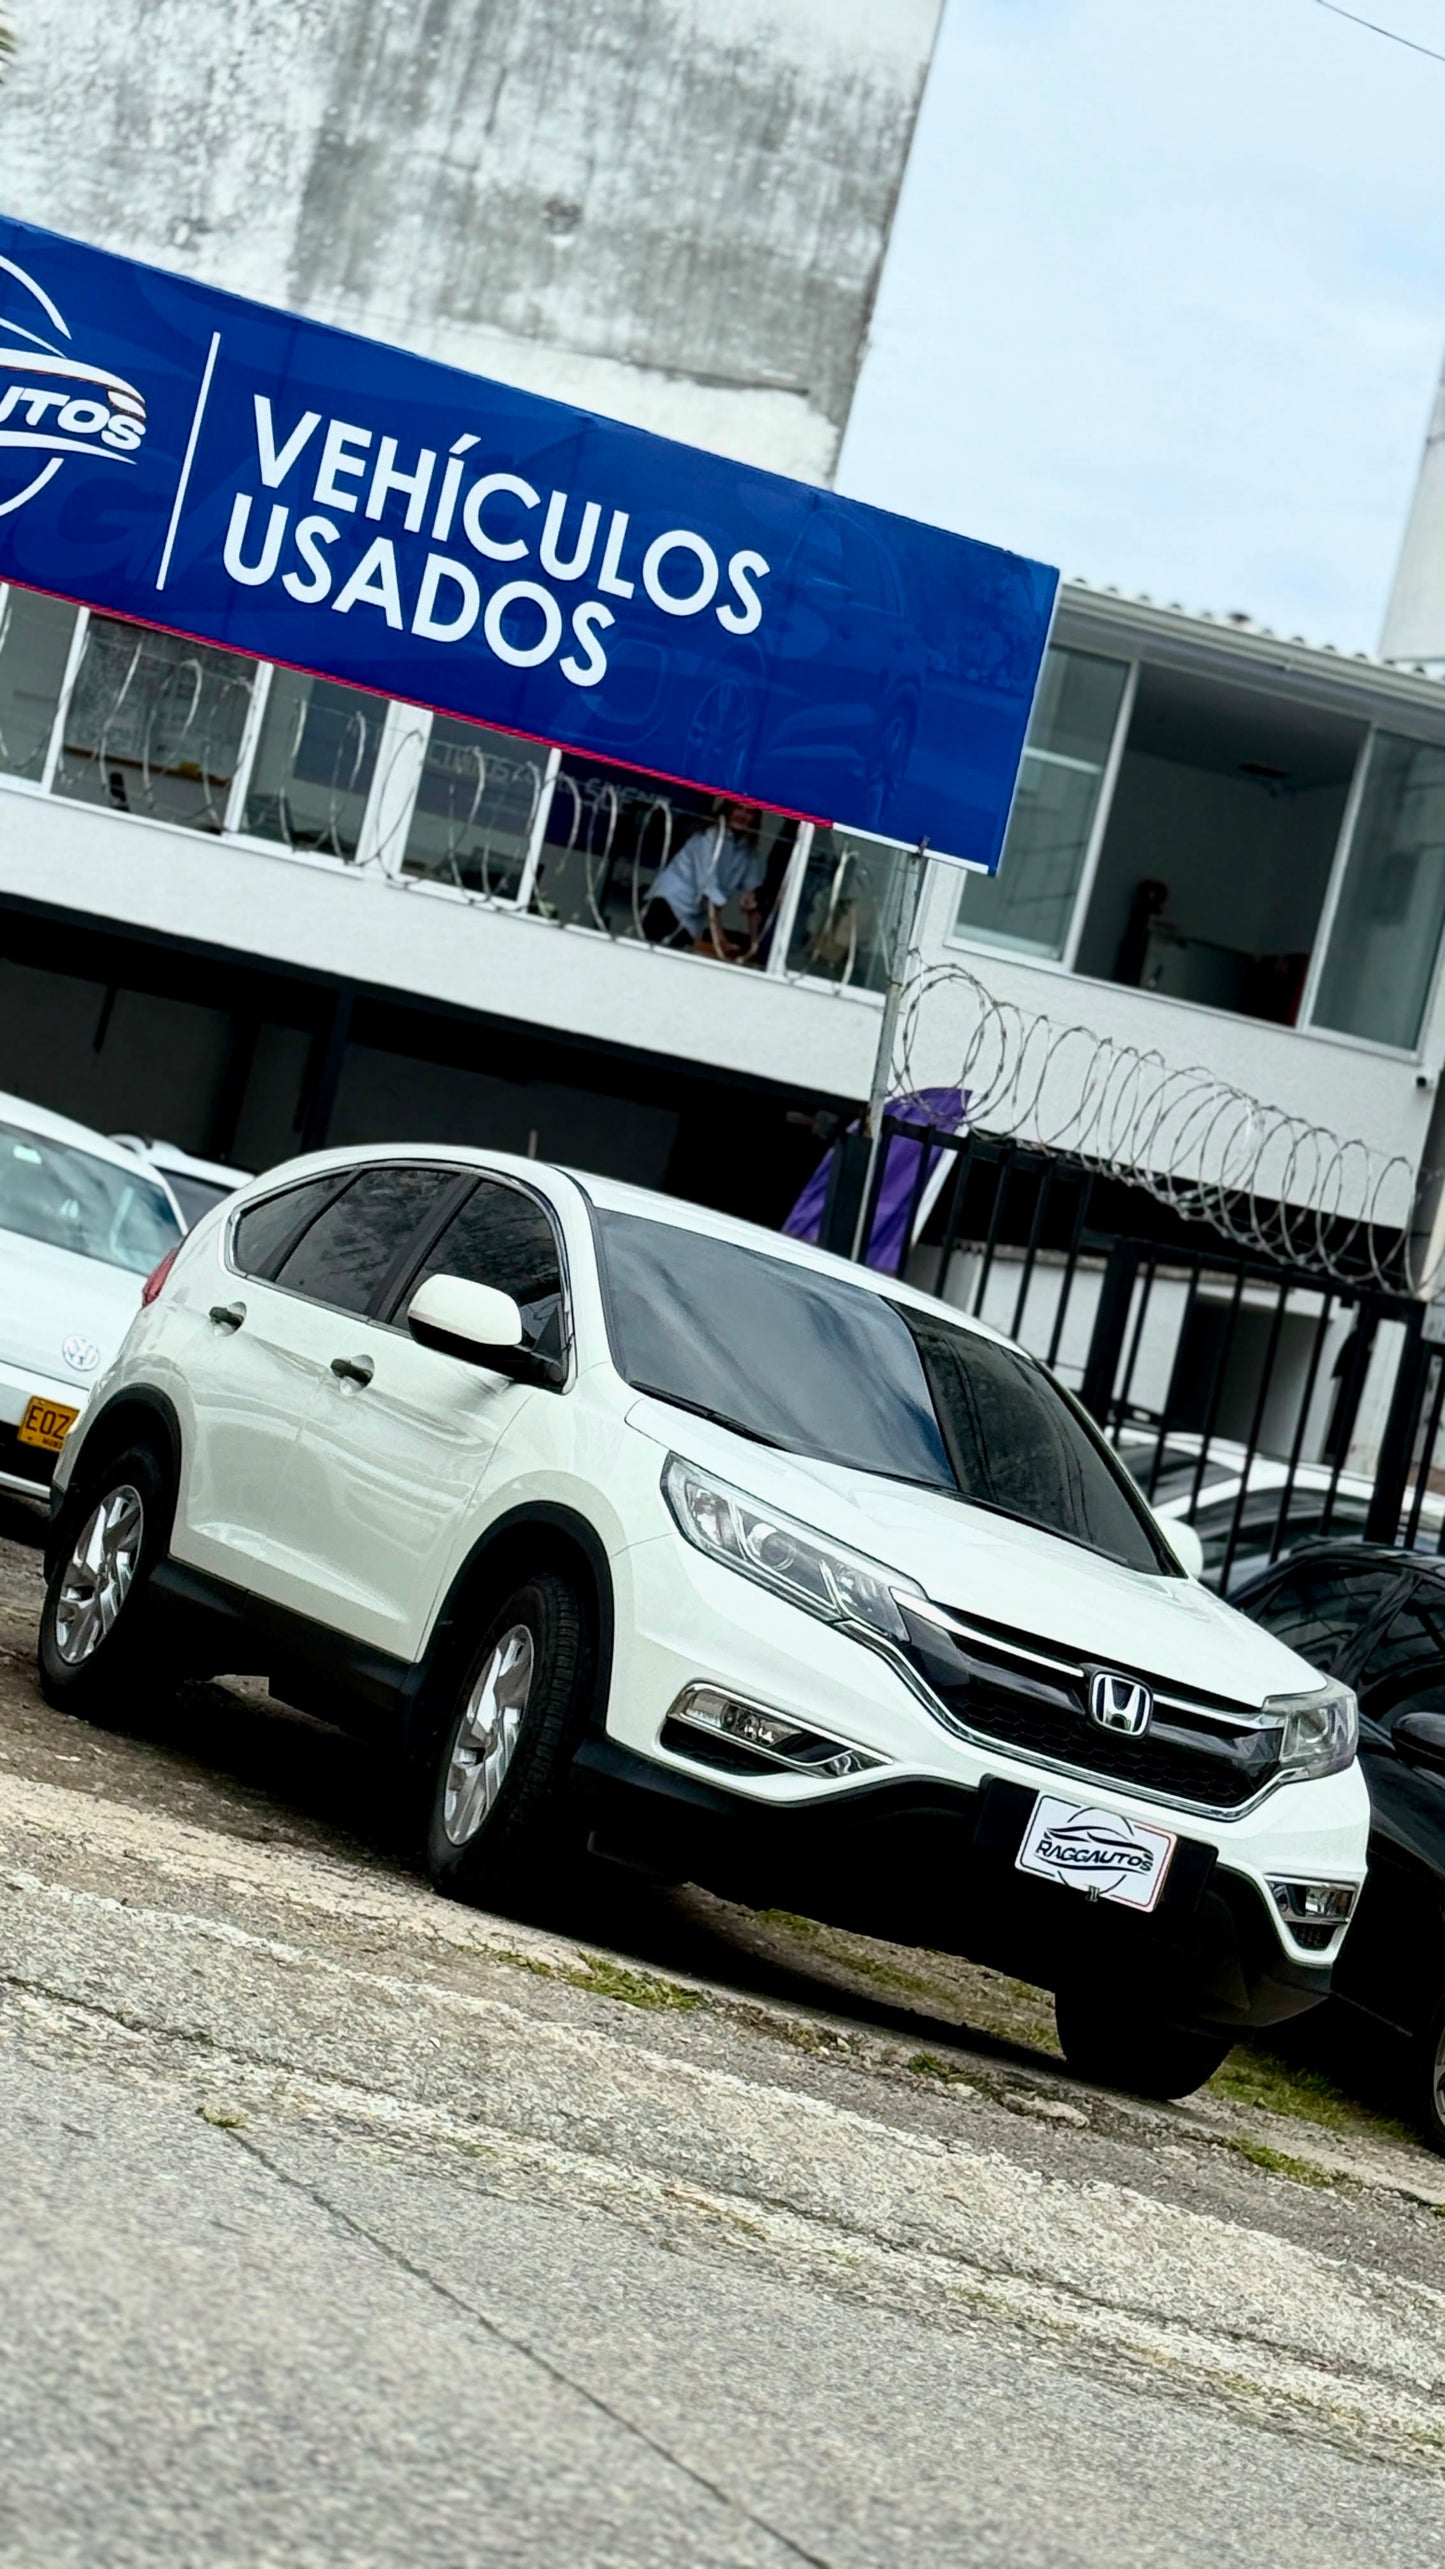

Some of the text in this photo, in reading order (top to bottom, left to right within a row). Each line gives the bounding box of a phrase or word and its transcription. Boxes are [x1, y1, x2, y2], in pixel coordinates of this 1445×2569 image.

[223, 492, 616, 687] USADOS
[253, 394, 771, 636] VEHÍCULOS
[1034, 1839, 1154, 1872] RAGGAUTOS
